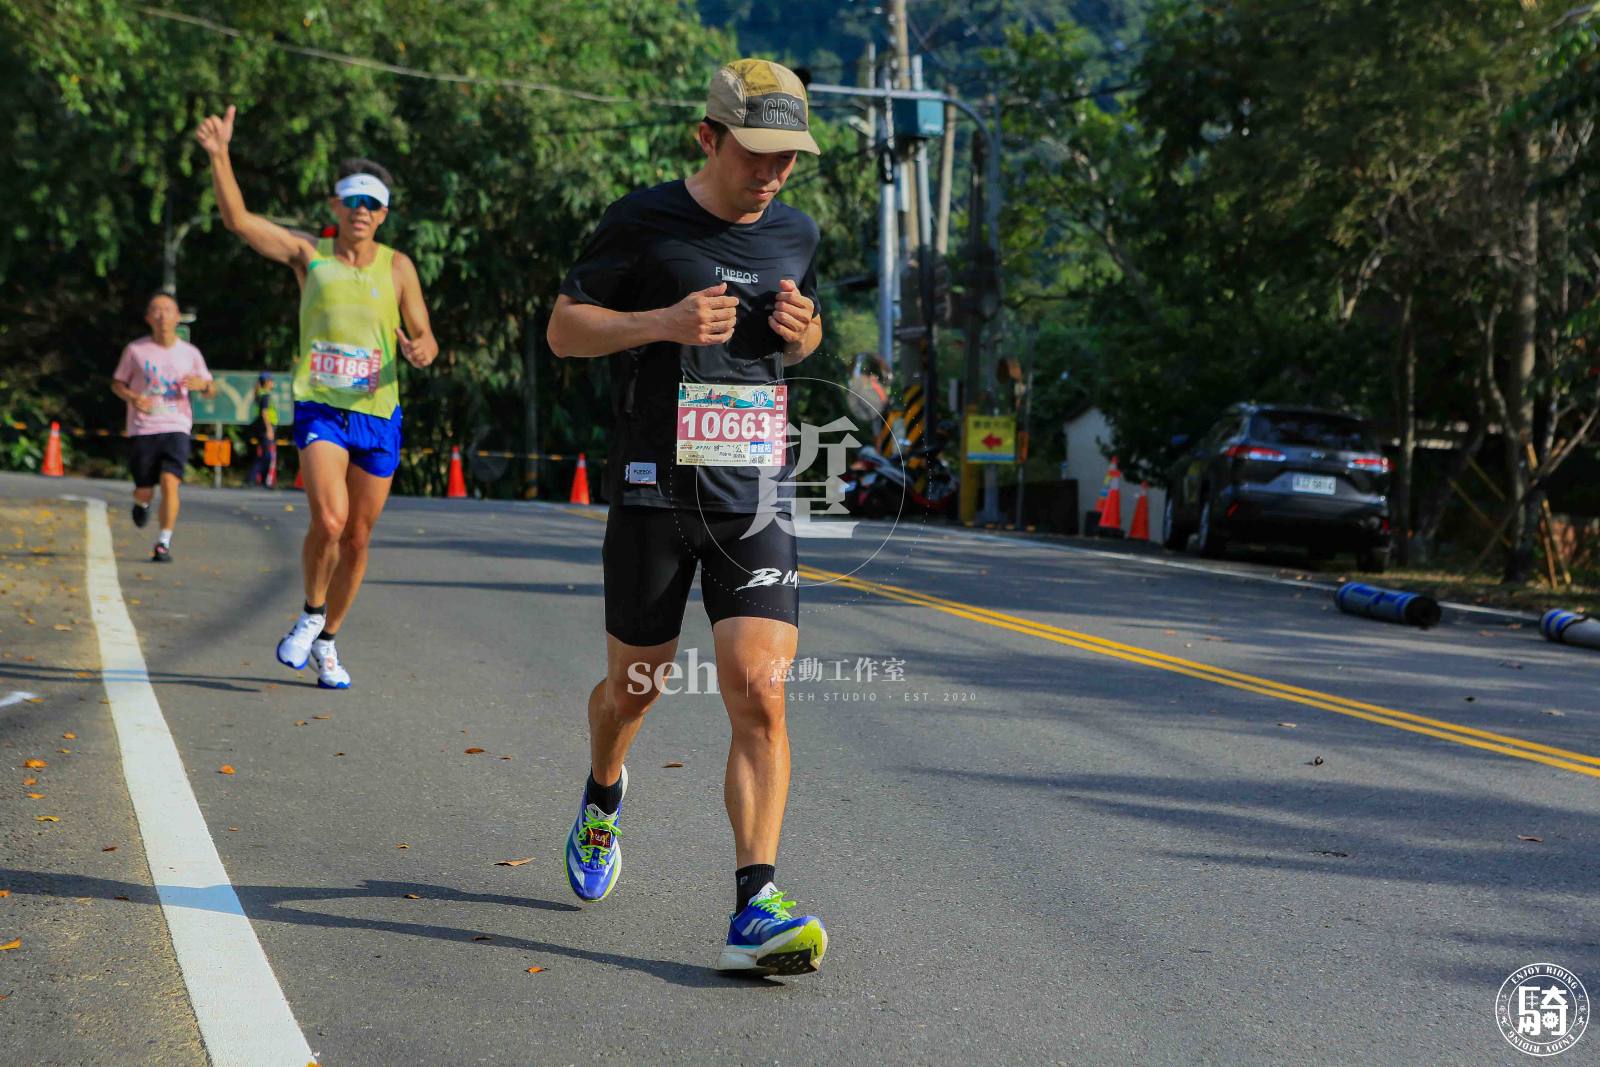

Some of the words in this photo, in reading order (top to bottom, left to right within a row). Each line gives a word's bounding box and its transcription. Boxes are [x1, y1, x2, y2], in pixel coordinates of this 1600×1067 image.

[763, 98, 800, 126] GRC
[715, 266, 759, 283] FLIPPOS
[313, 355, 369, 378] 10186
[682, 410, 771, 440] 10663
